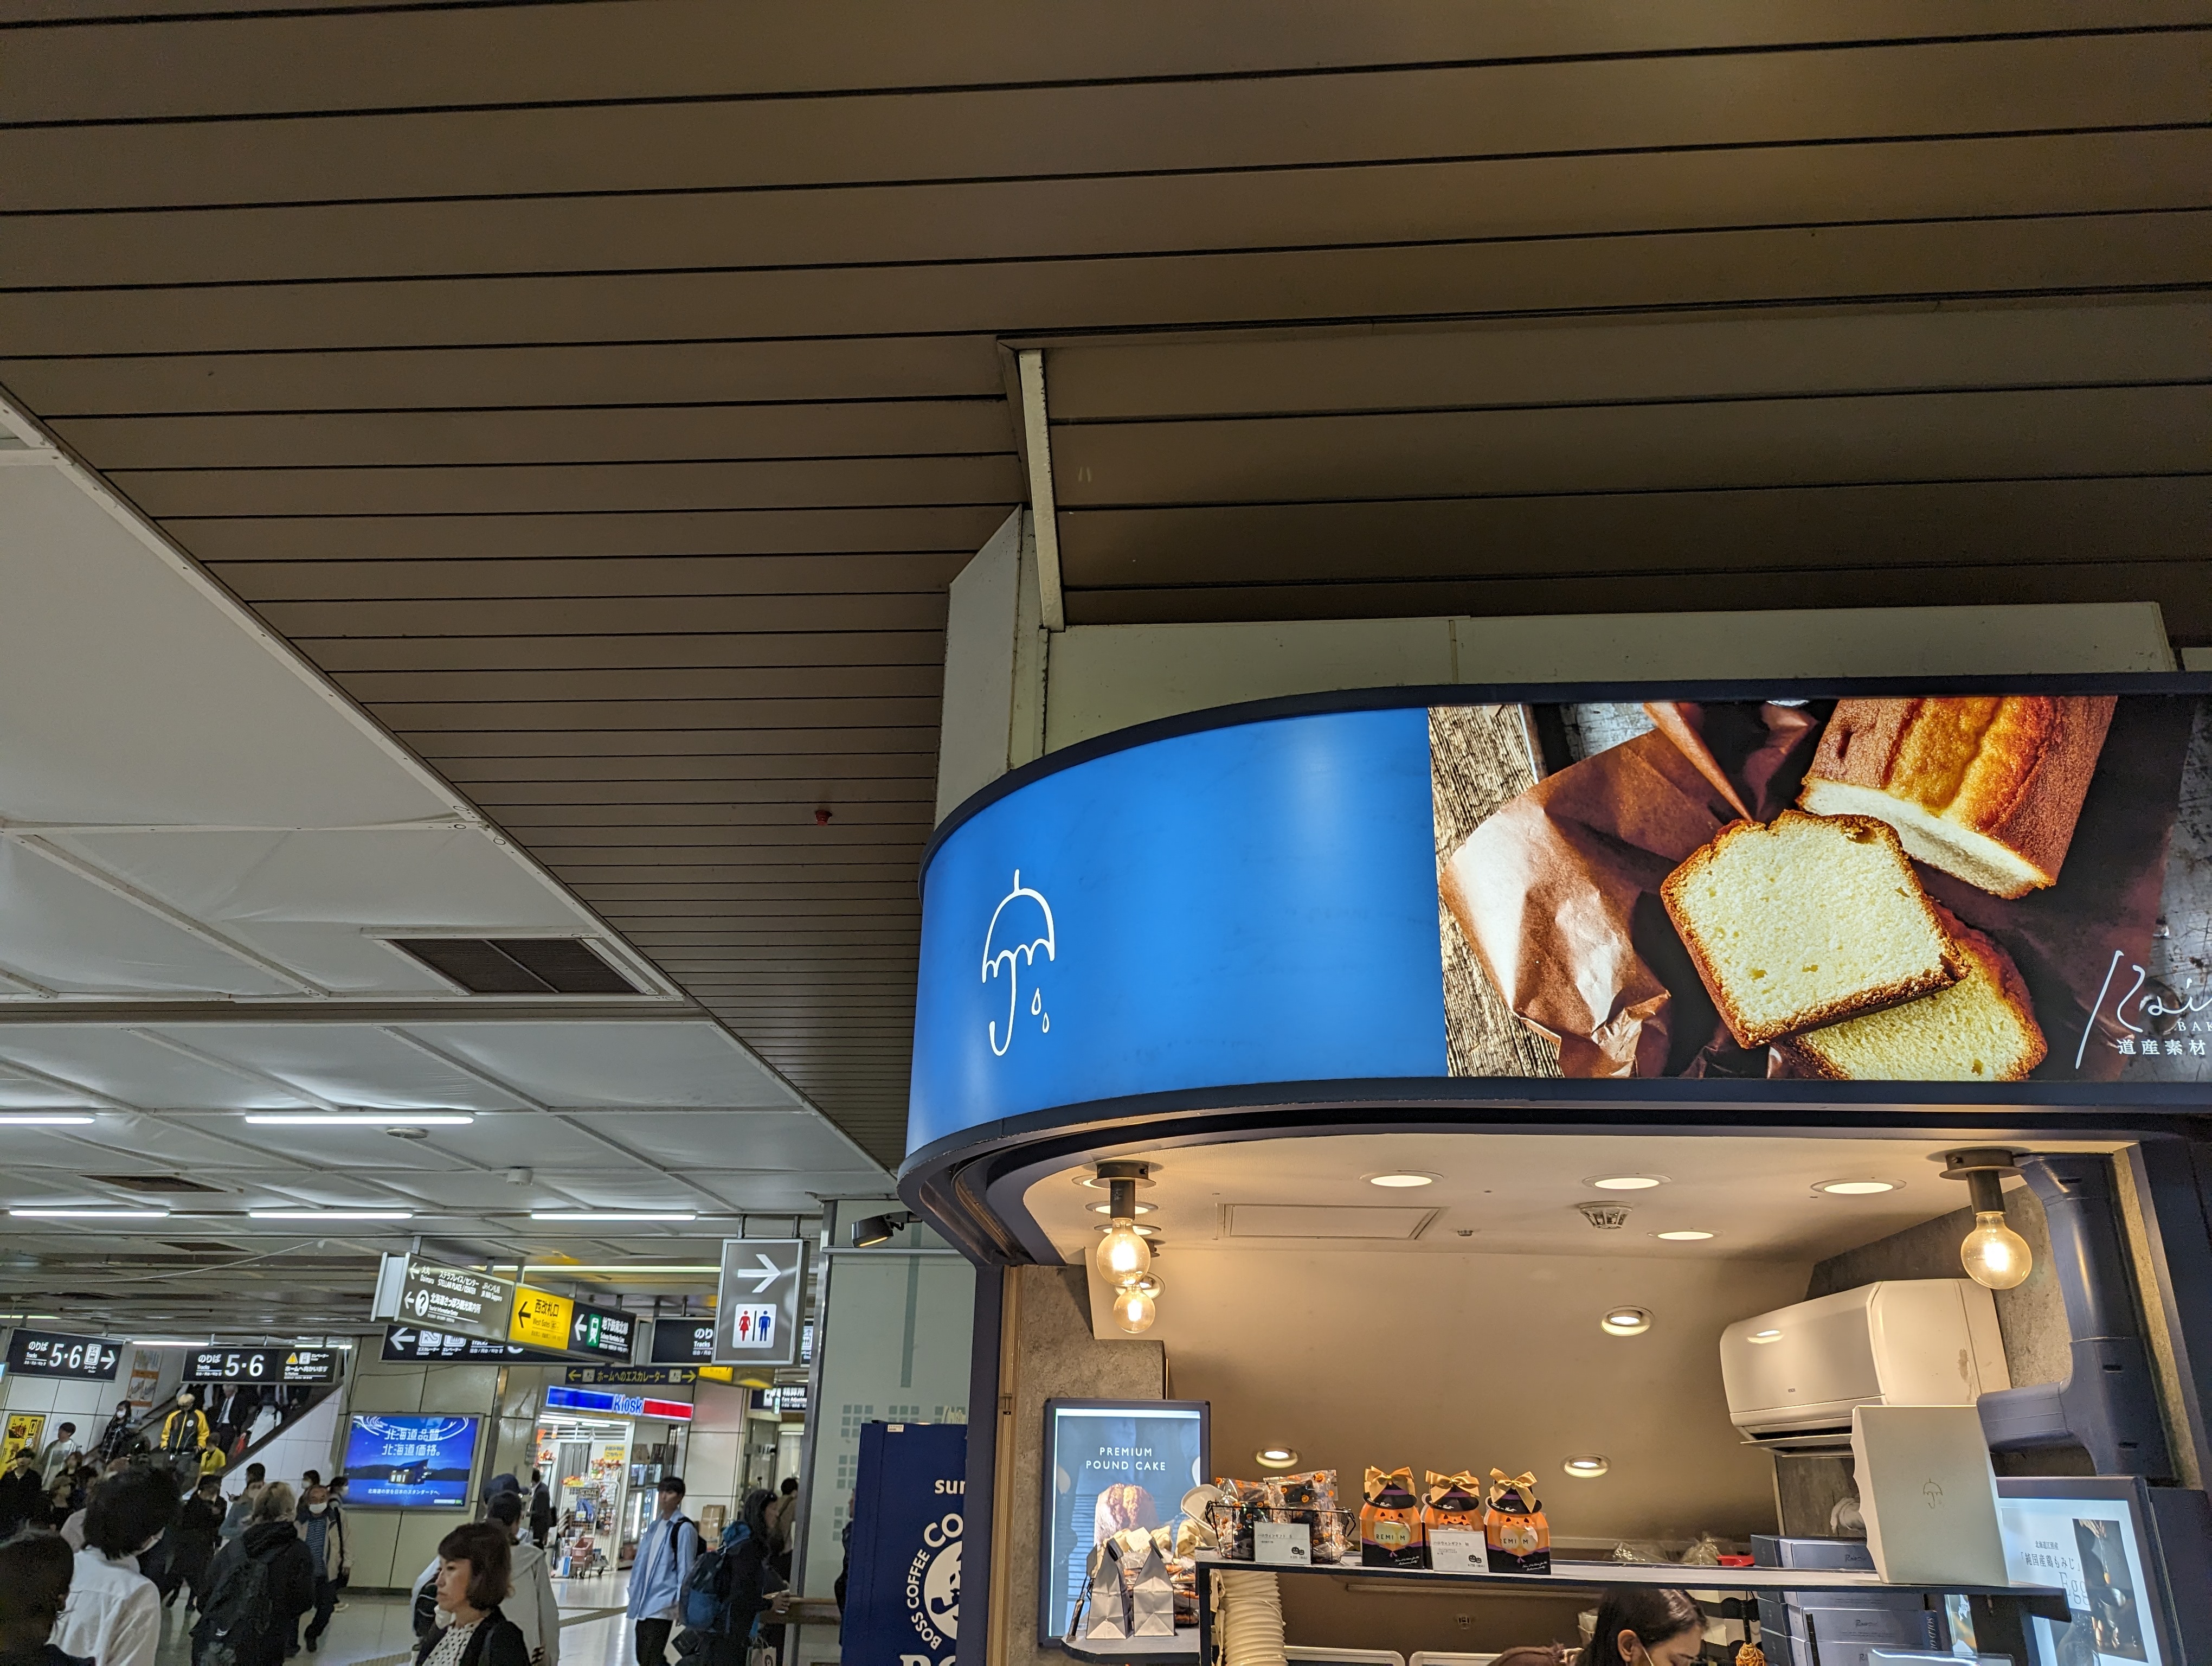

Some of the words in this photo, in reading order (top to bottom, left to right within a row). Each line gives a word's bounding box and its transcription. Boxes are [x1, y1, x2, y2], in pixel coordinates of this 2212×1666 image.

[2116, 1039, 2205, 1055] 道産素材
[535, 1299, 560, 1317] 西改札口
[29, 1341, 48, 1351] のりば
[198, 1354, 221, 1363] のりば
[597, 1370, 666, 1382] ホームへのエスカレーター
[614, 1394, 643, 1415] Kiosk
[382, 1444, 440, 1456] 北海道価格。
[1099, 1447, 1152, 1457] PREMIUM
[1086, 1460, 1129, 1470] POUND
[1135, 1462, 1166, 1471] CAKE
[906, 1549, 930, 1609] COFFEE
[2059, 1572, 2089, 1605] Egg
[911, 1612, 942, 1650] BOSS
